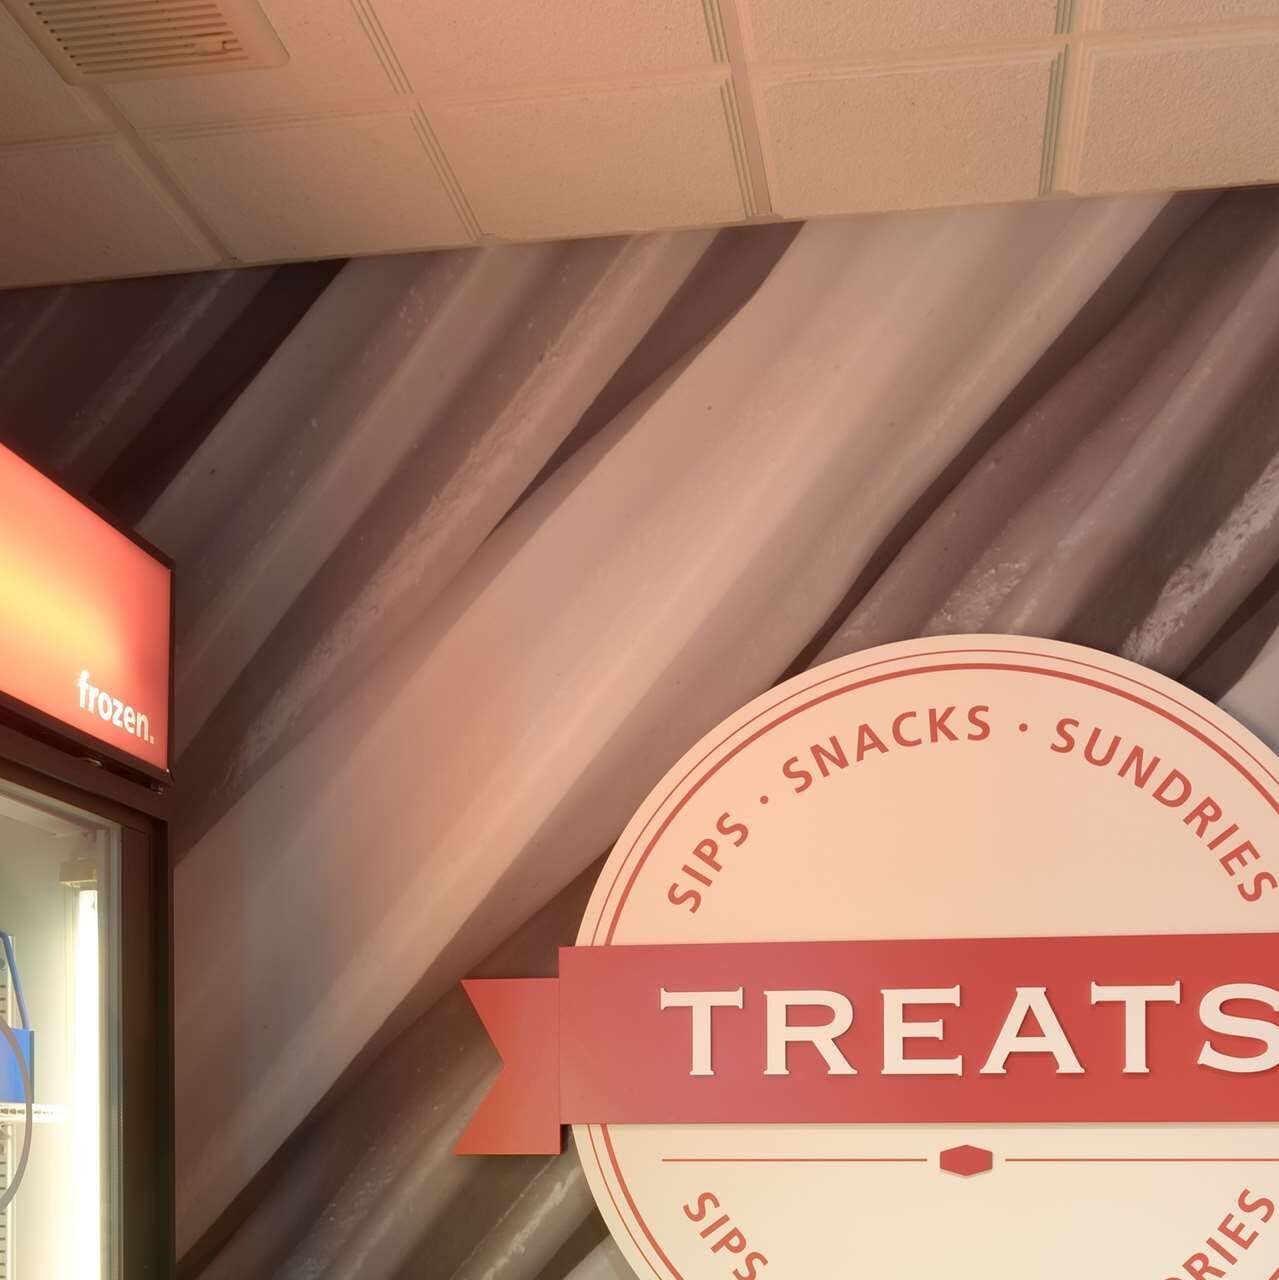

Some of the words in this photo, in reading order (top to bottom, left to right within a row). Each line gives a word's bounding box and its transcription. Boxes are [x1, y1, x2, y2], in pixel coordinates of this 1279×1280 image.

[77, 669, 155, 744] frozen.
[667, 811, 751, 914] SIPS
[781, 704, 993, 795] SNACKS
[1049, 716, 1279, 905] SUNDRIES
